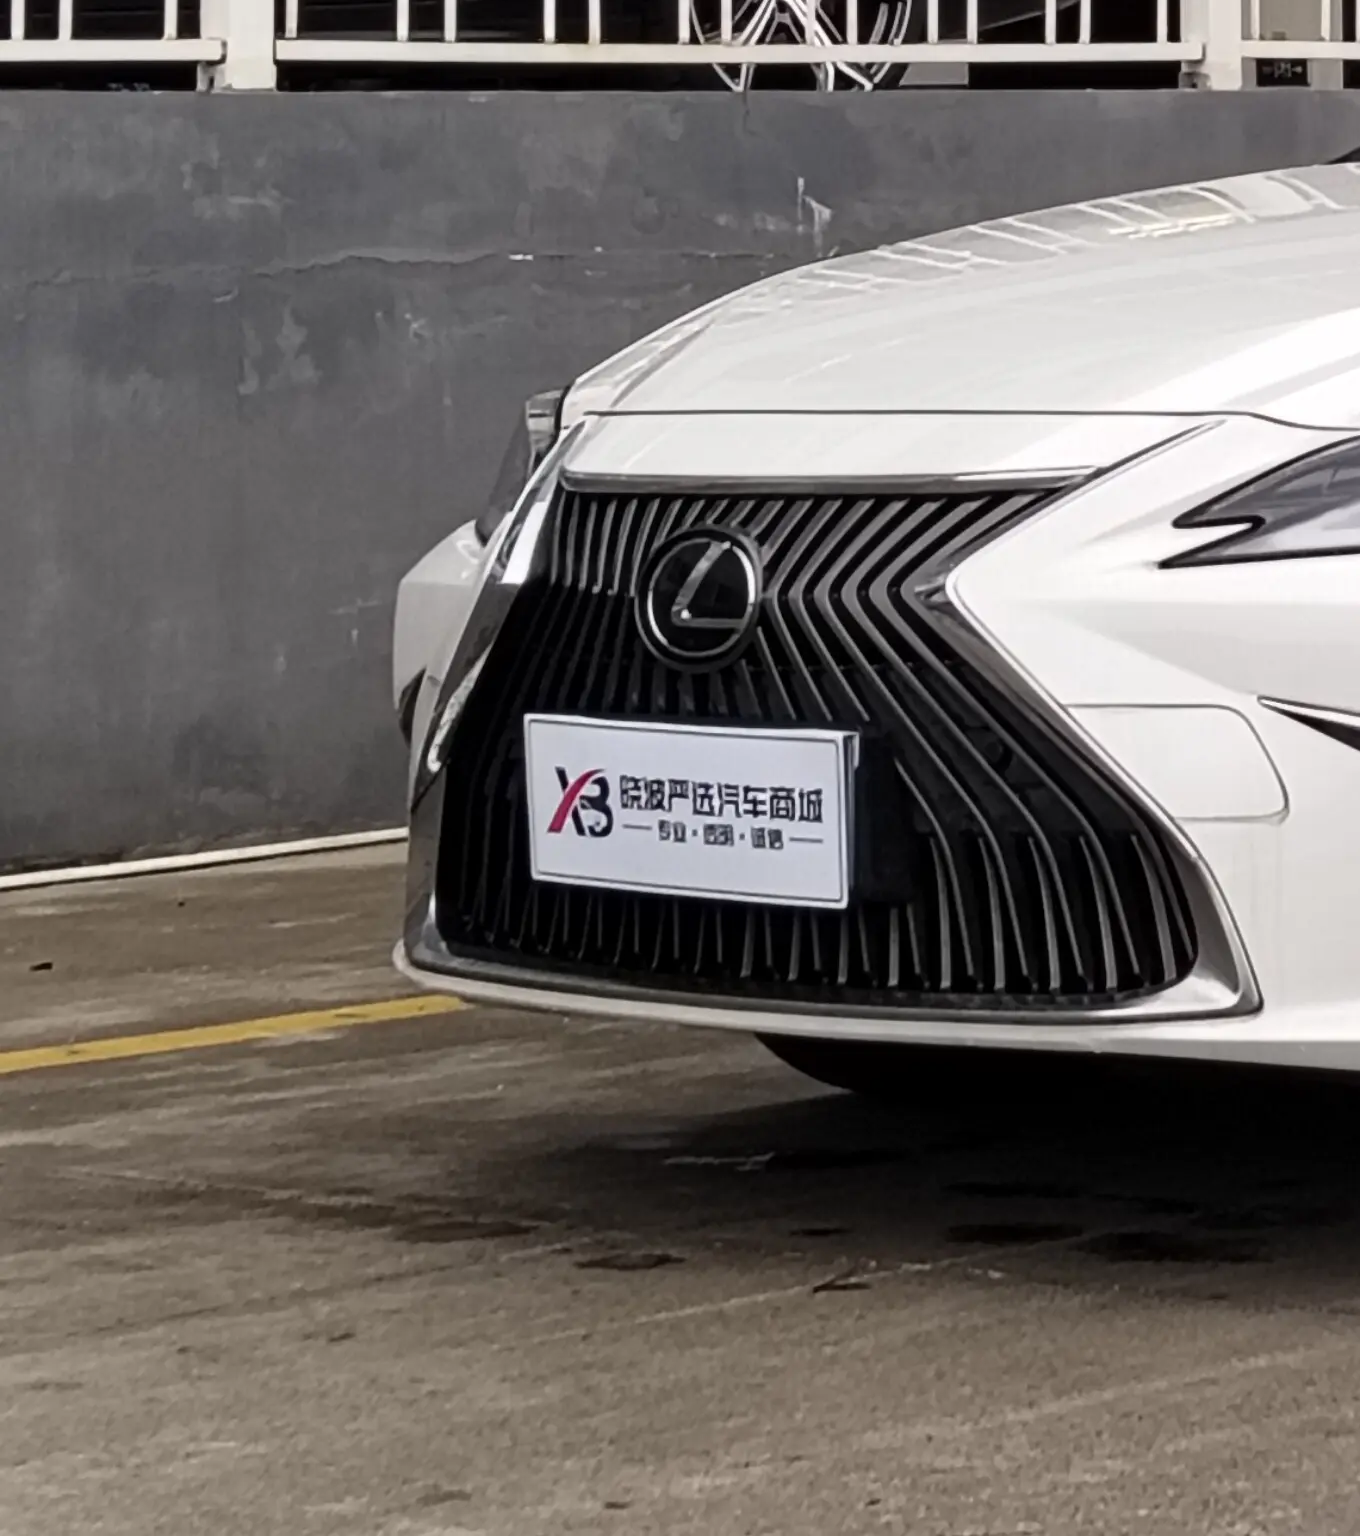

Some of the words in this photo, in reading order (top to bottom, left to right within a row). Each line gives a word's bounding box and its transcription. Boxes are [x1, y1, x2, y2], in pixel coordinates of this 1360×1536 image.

[619, 774, 824, 824] 晓波严选汽车商城
